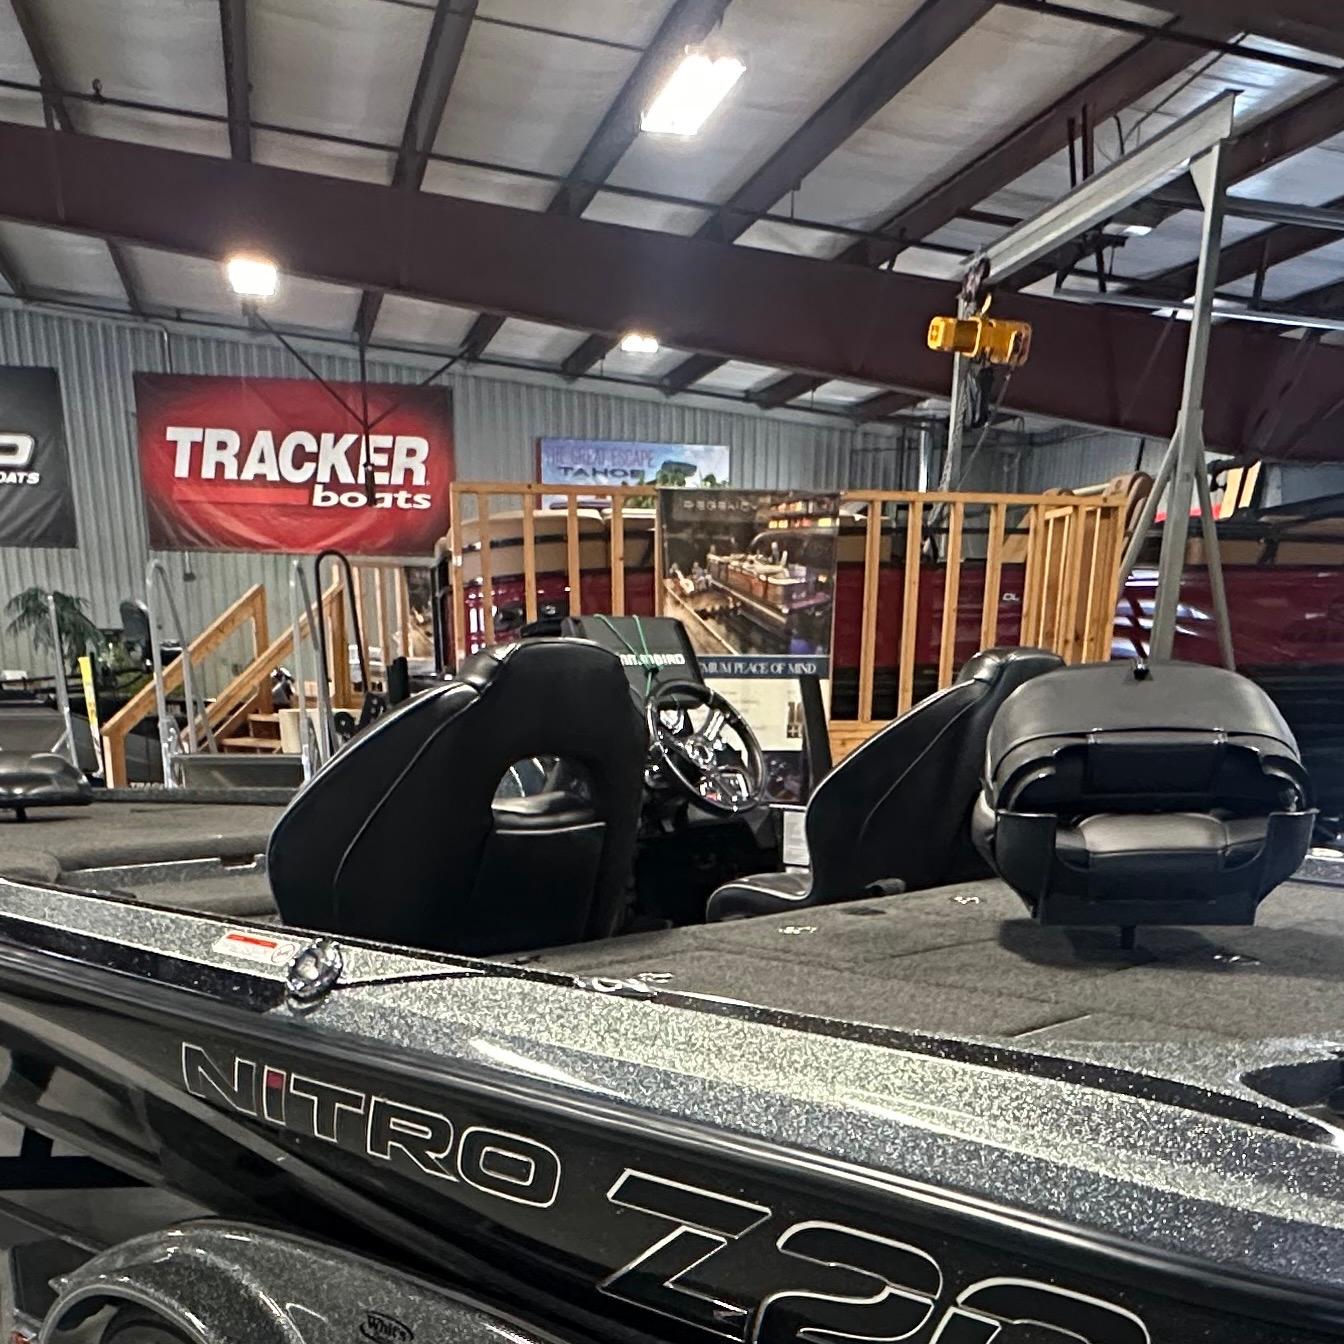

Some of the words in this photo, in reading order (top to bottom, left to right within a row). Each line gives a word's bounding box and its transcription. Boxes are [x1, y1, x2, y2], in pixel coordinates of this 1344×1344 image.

[166, 426, 430, 486] TRACKER
[557, 466, 645, 479] TAHOE
[313, 483, 432, 509] boats
[734, 661, 769, 675] PEACE
[770, 662, 786, 674] OF
[787, 662, 817, 675] MIND
